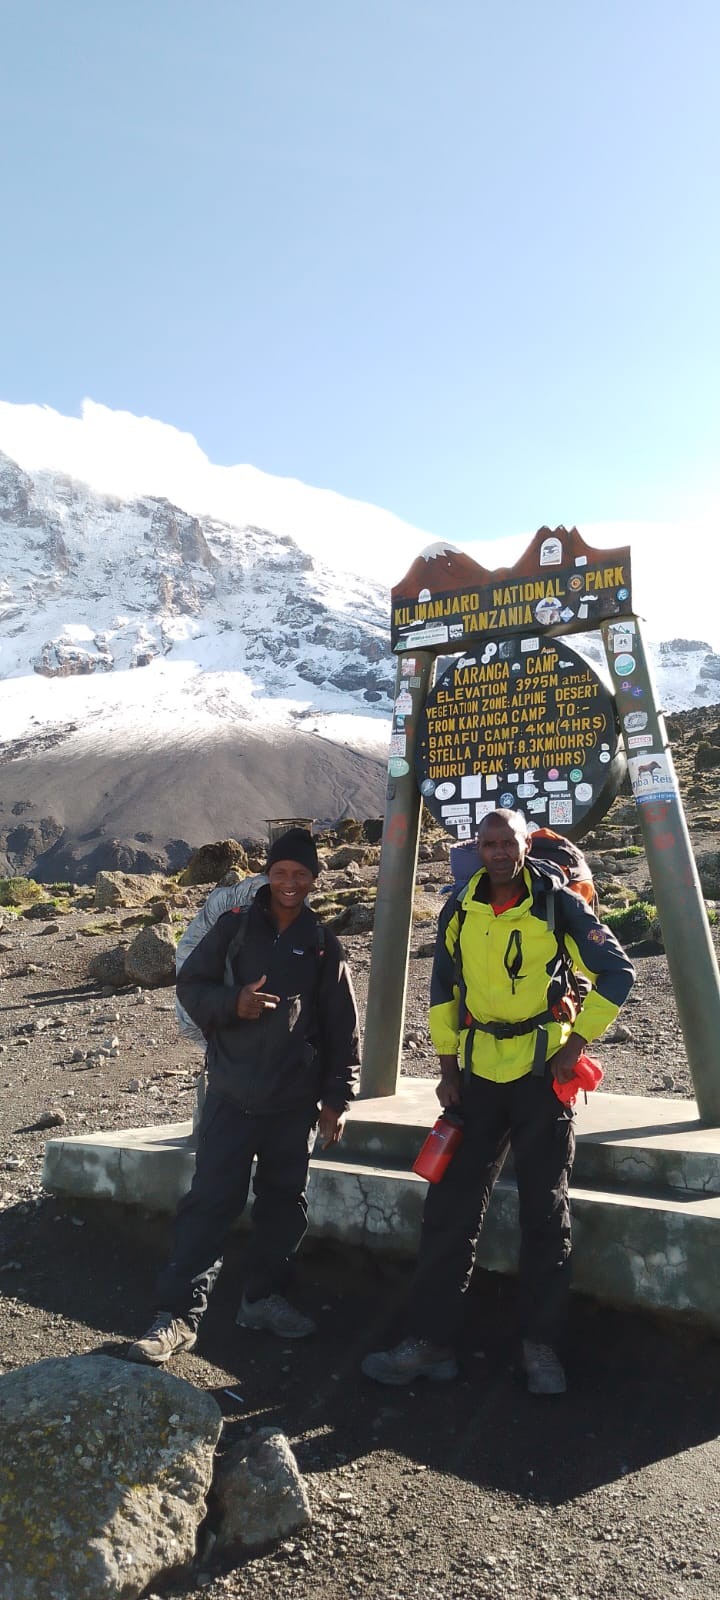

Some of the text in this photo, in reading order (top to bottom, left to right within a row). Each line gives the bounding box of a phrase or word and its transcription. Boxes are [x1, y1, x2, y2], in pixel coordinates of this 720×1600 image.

[395, 566, 624, 625] KILIMANJARO NATIONAL PARK
[463, 605, 532, 632] TANZANIA
[454, 654, 558, 686] KARANGA CAMP
[426, 701, 478, 719] VEGETATION
[555, 684, 598, 701] DESERT
[437, 682, 507, 703] ELEVATION
[516, 674, 558, 691] 3995M
[428, 718, 455, 734] FROM
[459, 711, 508, 730] KARANGA
[512, 706, 546, 723] CAMP
[429, 731, 478, 749] BARAFU
[429, 746, 471, 763] STELLA
[429, 762, 465, 779] UHURU
